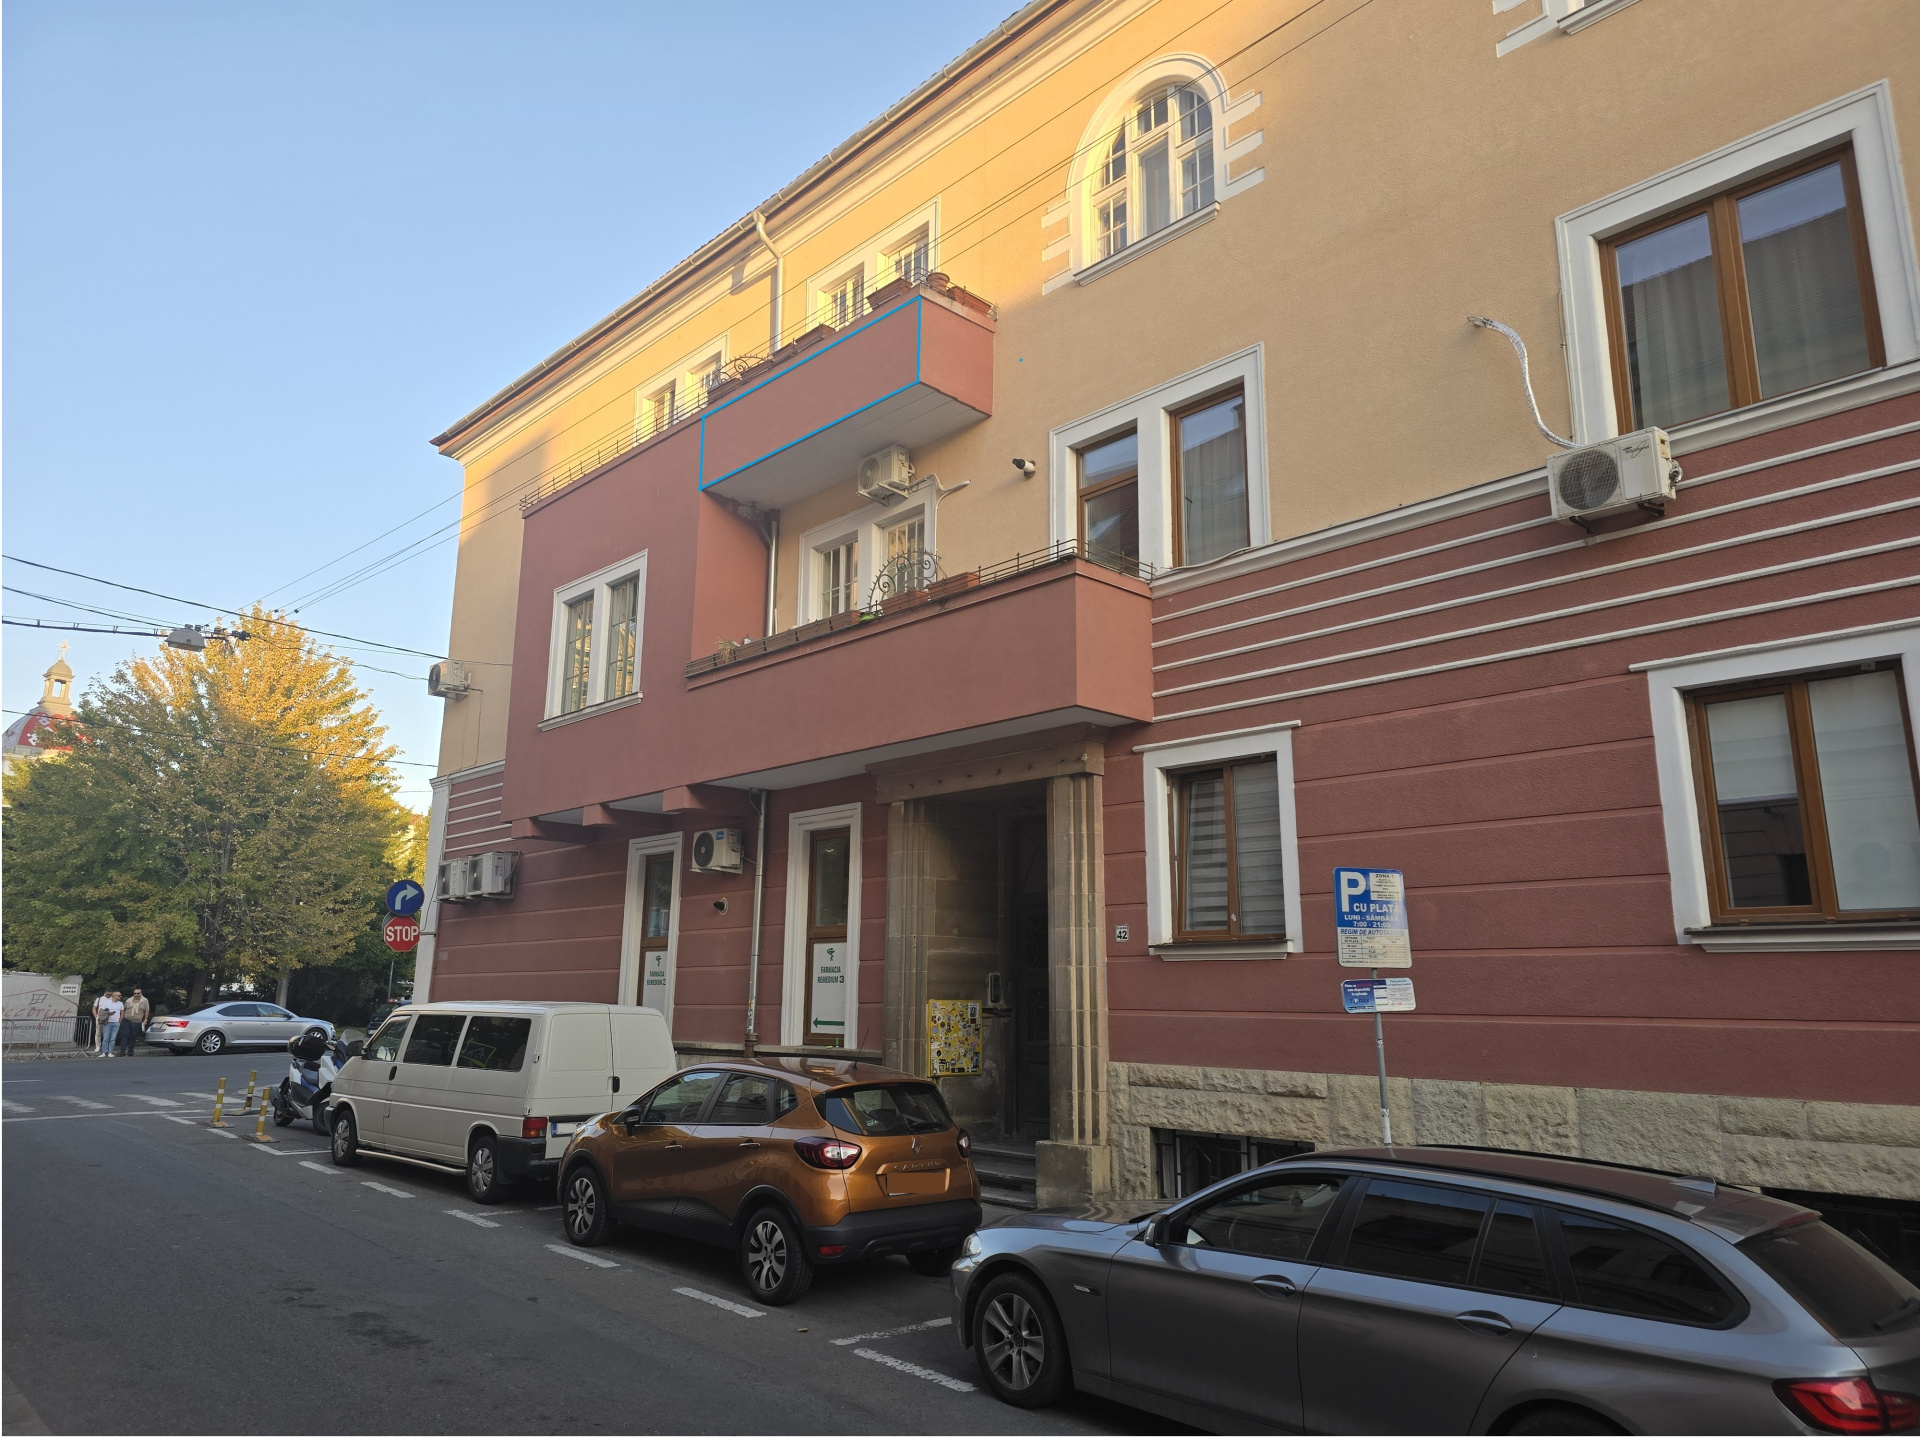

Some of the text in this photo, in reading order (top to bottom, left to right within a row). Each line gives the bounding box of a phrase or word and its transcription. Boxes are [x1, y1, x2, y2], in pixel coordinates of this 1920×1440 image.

[1340, 871, 1366, 912] P
[1353, 902, 1400, 913] CU PLATĂ
[386, 925, 419, 942] STOP
[1116, 930, 1128, 940] 42
[839, 975, 844, 983] 3
[2, 1004, 73, 1017] ecorint
